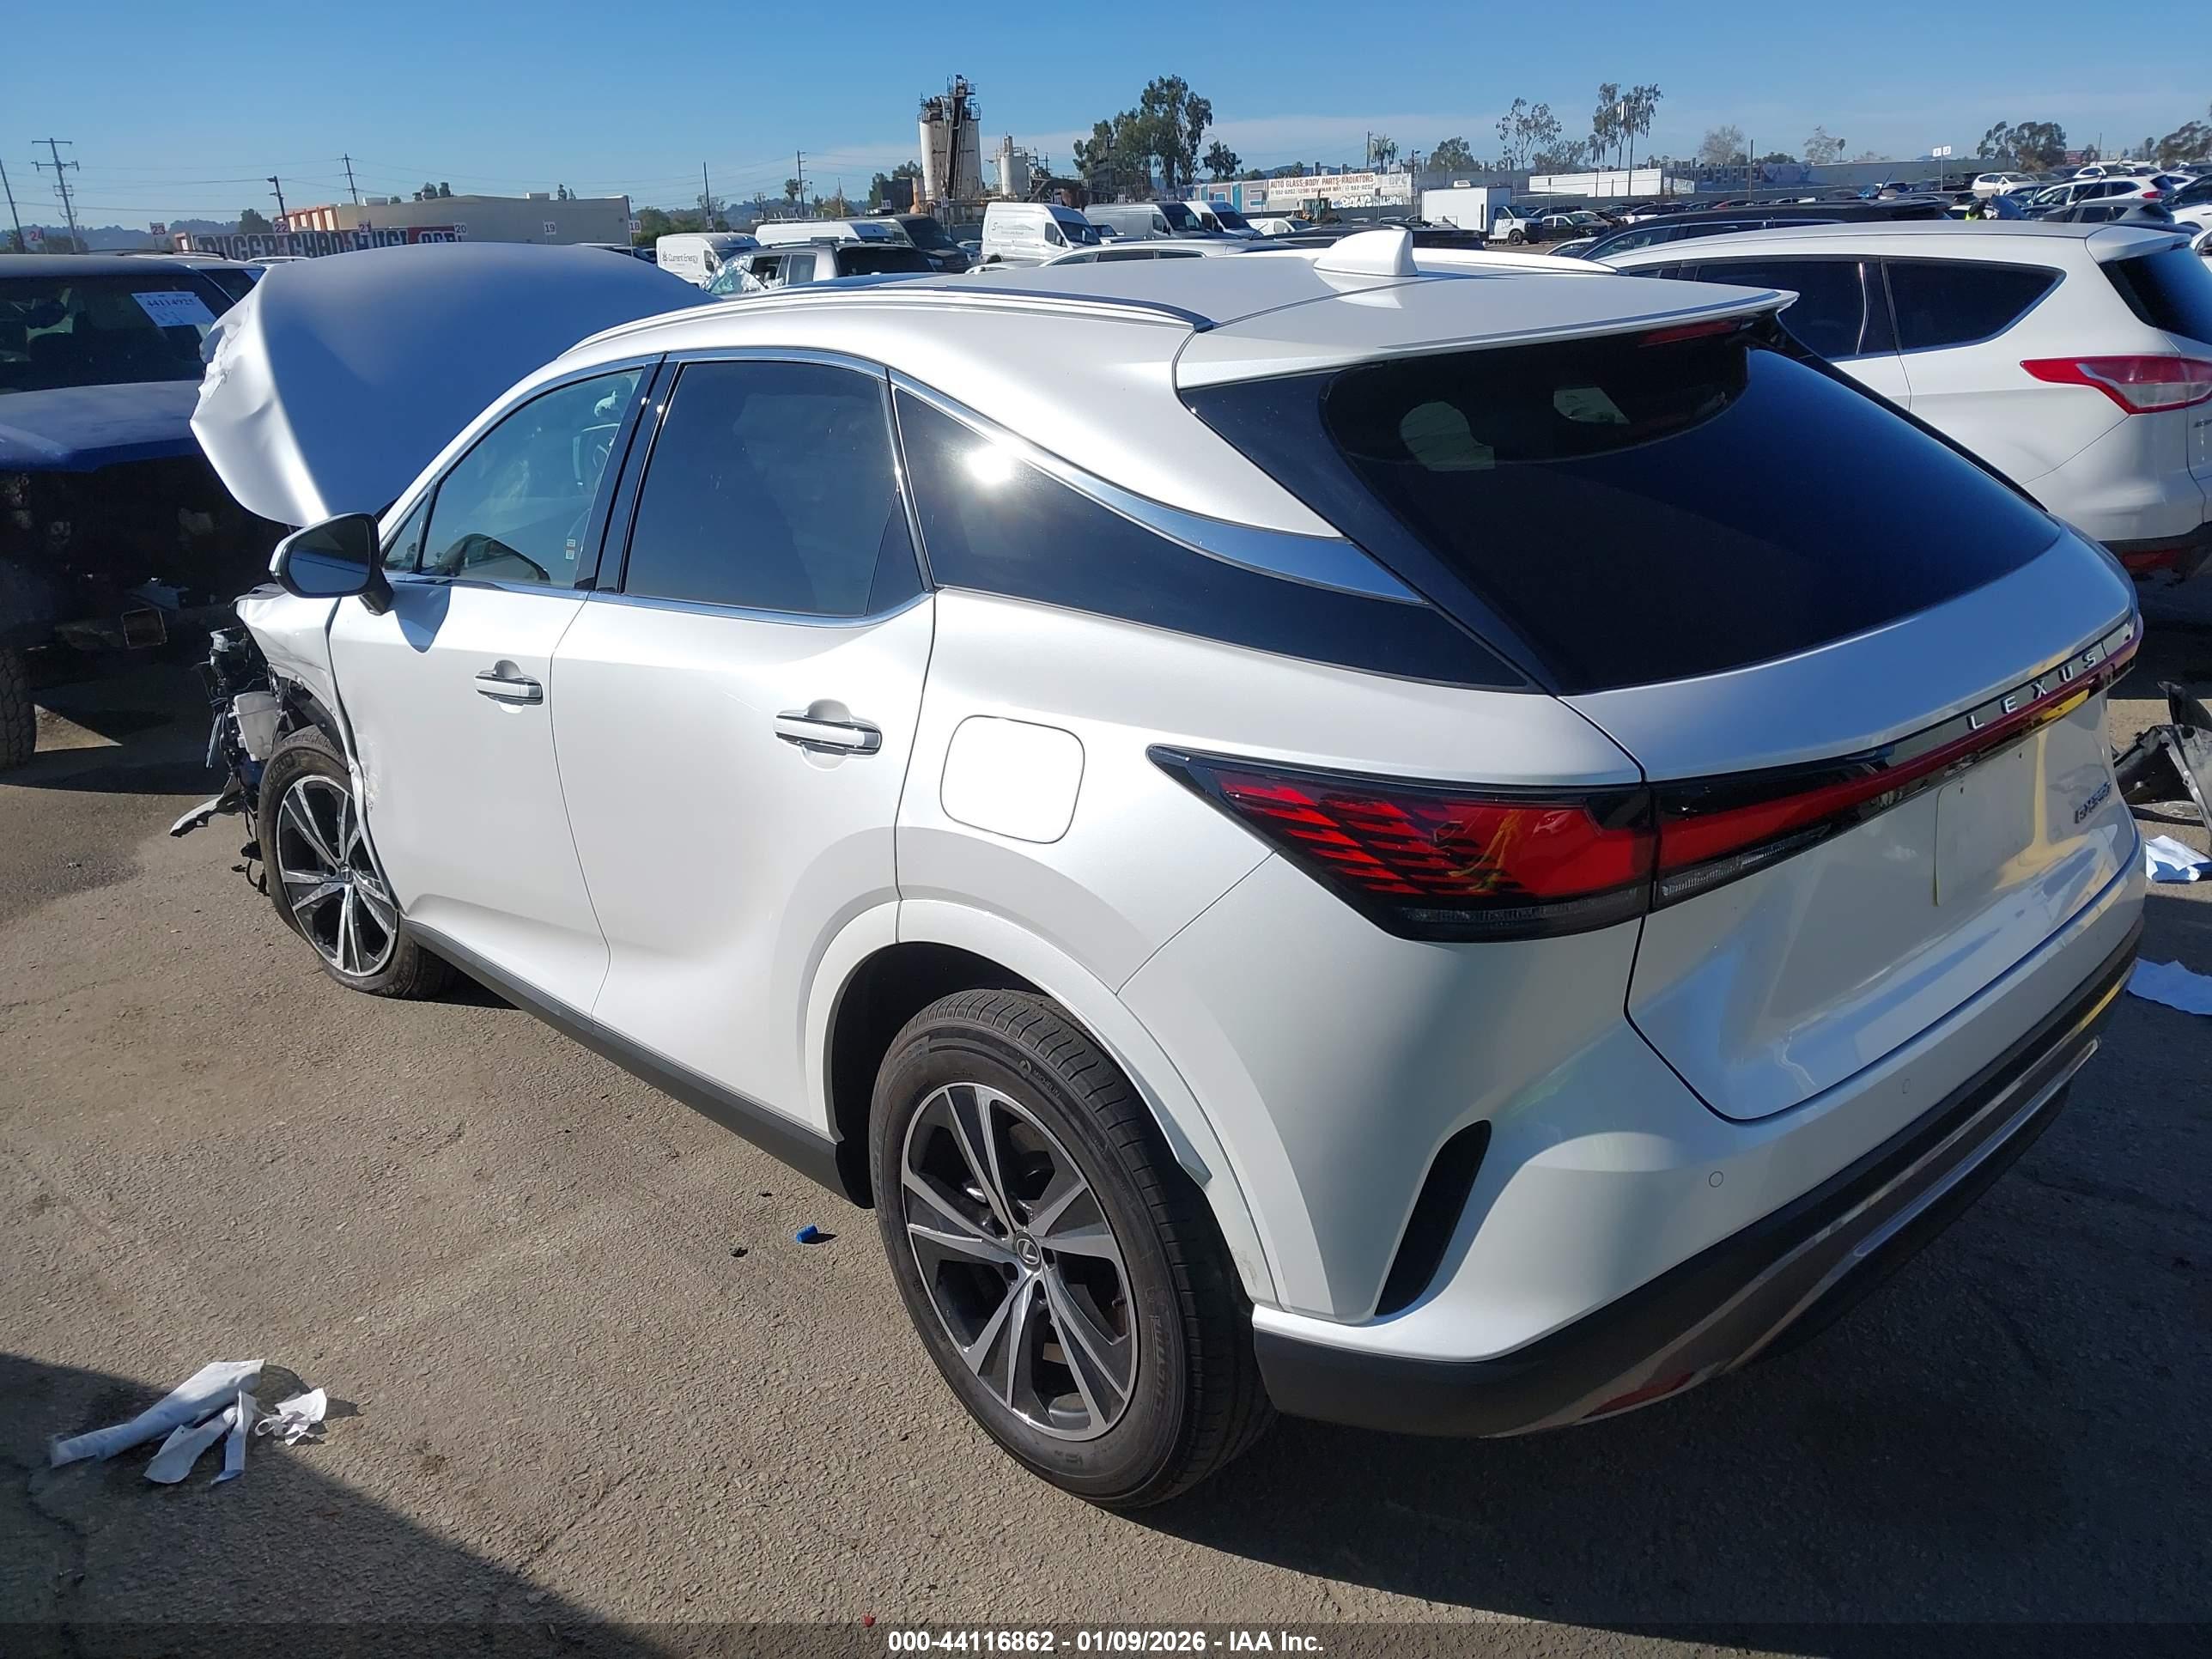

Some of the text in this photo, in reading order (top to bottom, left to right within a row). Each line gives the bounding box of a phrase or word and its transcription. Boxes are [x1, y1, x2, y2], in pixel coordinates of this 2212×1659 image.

[150, 225, 166, 235] 23
[274, 223, 289, 234] 22
[455, 224, 467, 234] 20
[544, 223, 556, 233] 19
[629, 222, 640, 232] 18
[1967, 651, 2096, 730] LEXUS
